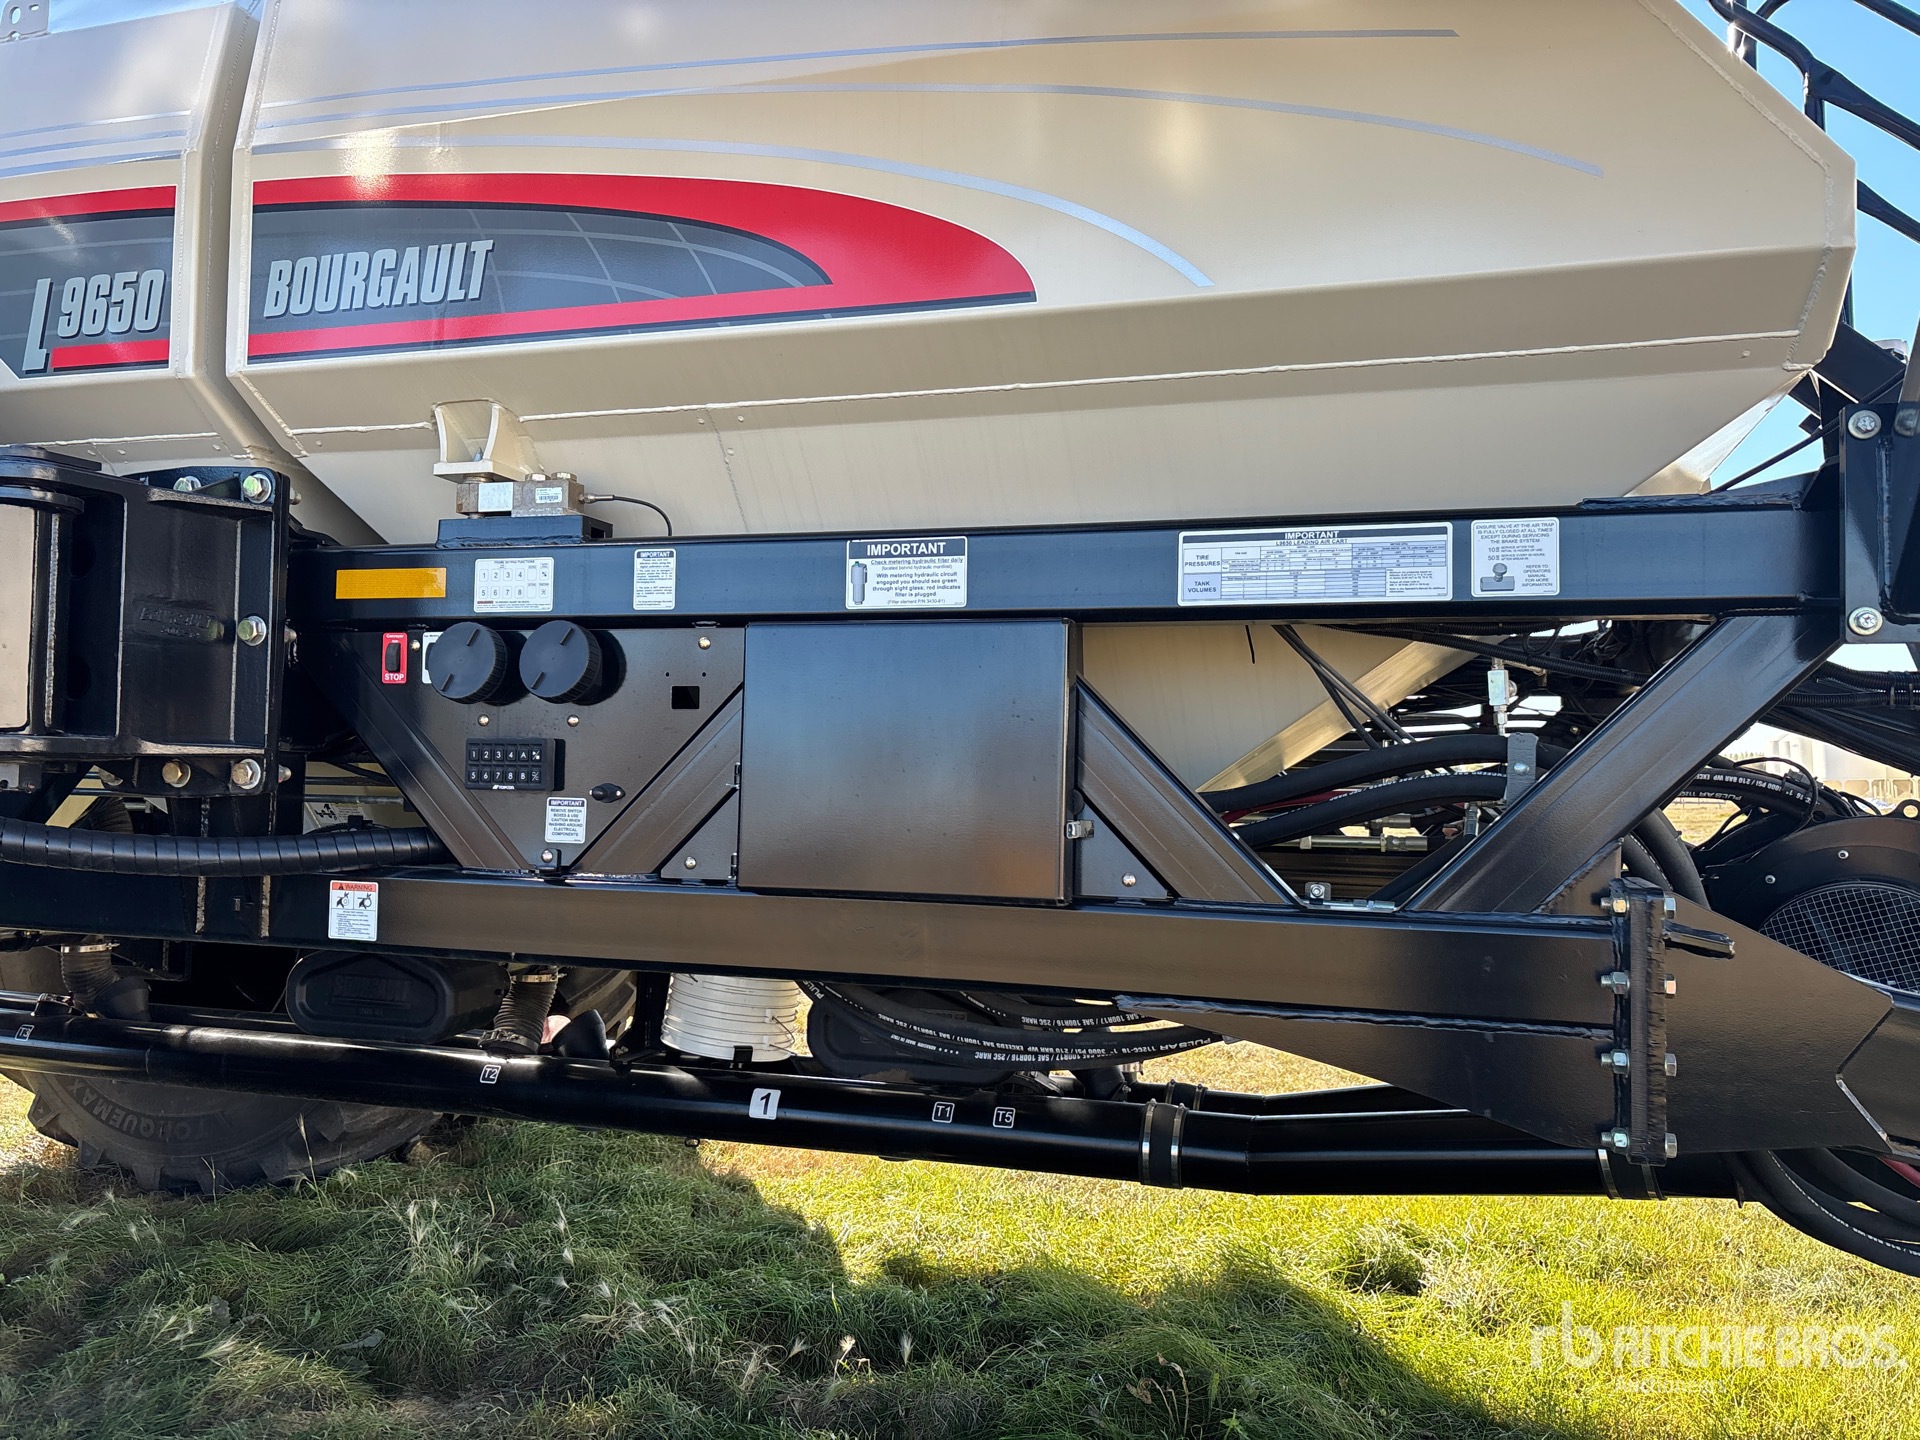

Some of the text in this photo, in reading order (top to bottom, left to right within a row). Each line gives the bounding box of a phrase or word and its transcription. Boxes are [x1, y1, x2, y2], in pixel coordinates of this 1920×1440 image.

[264, 239, 494, 318] BOURGAULT
[1285, 530, 1340, 540] IMPORTANT
[867, 542, 946, 556] IMPORTANT
[384, 673, 404, 681] STOP
[1083, 1018, 1094, 1027] SAE
[20, 1027, 31, 1038] T3
[1160, 1037, 1212, 1051] PULSAR
[975, 1051, 992, 1061] HARC
[1037, 1054, 1050, 1062] SAE
[485, 1068, 498, 1079] T2
[760, 1092, 772, 1115] 1
[936, 1105, 950, 1118] T1
[997, 1111, 1013, 1123] T5
